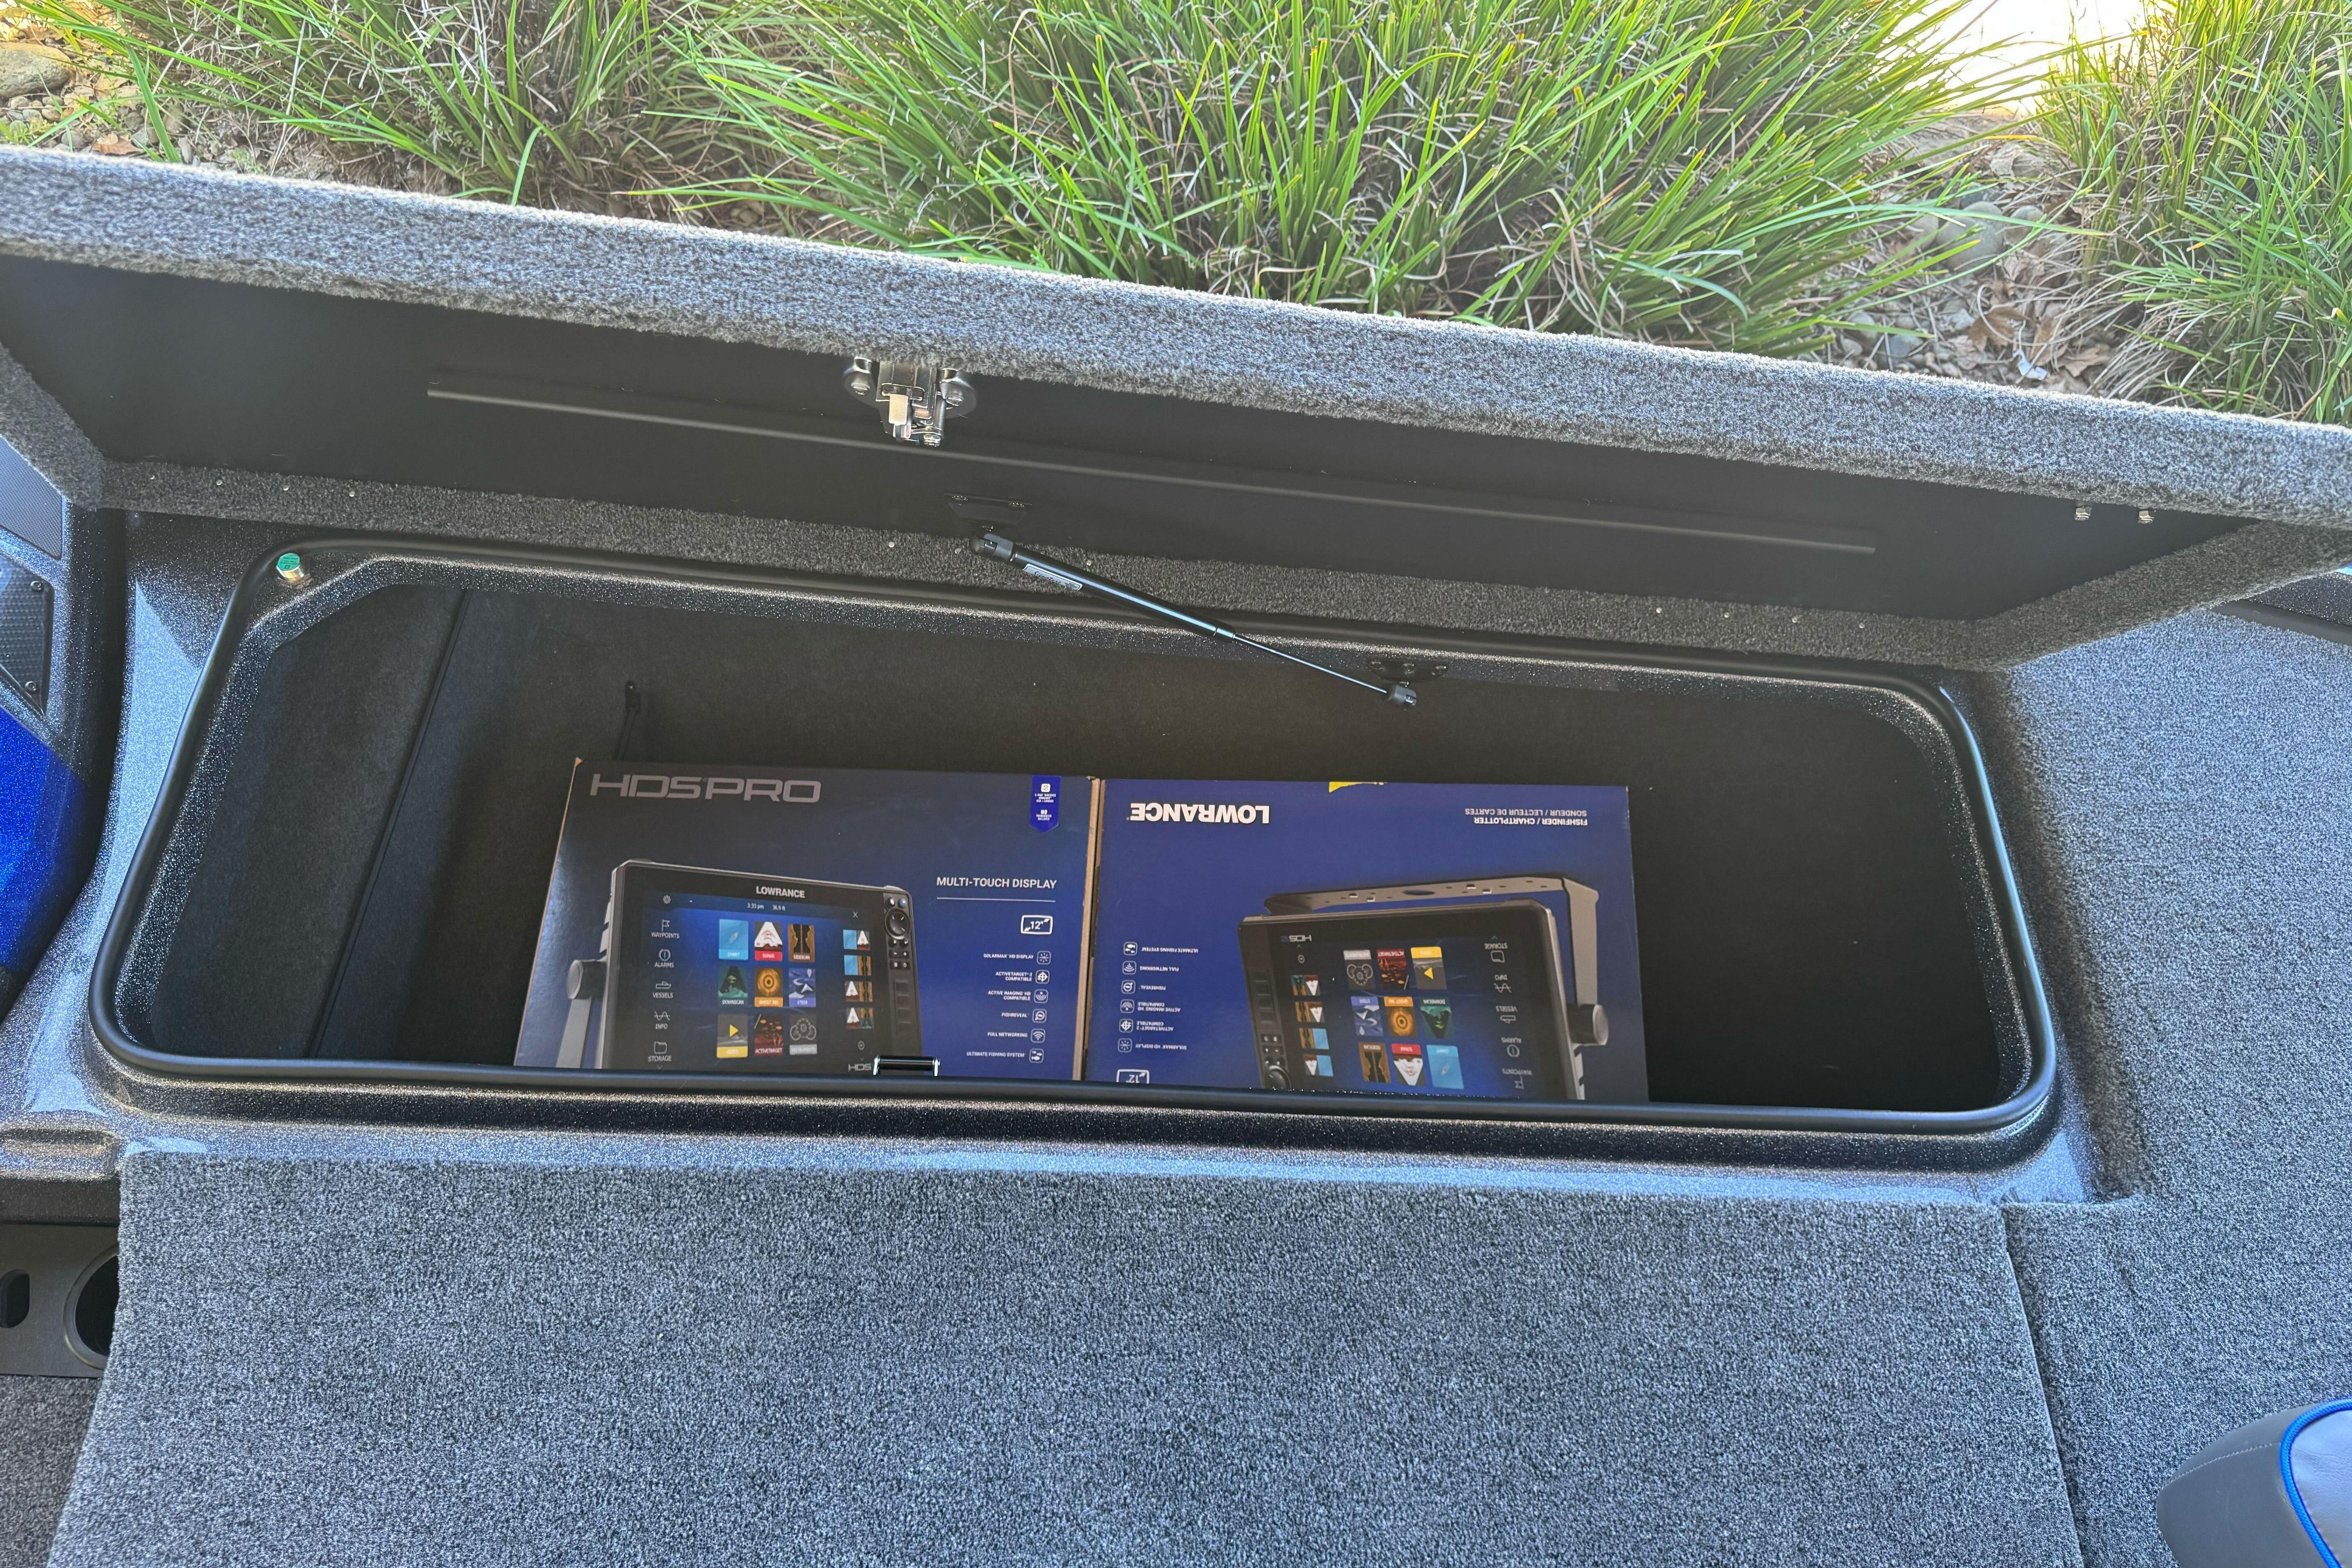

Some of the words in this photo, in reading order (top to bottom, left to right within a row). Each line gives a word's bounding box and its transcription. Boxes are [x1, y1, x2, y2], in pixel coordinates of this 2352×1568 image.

[1130, 803, 1269, 824] LOWRANCE
[936, 877, 1010, 887] MULTI-TOUCH
[1013, 879, 1057, 889] DISPLAY
[756, 886, 805, 898] LOWRANCE
